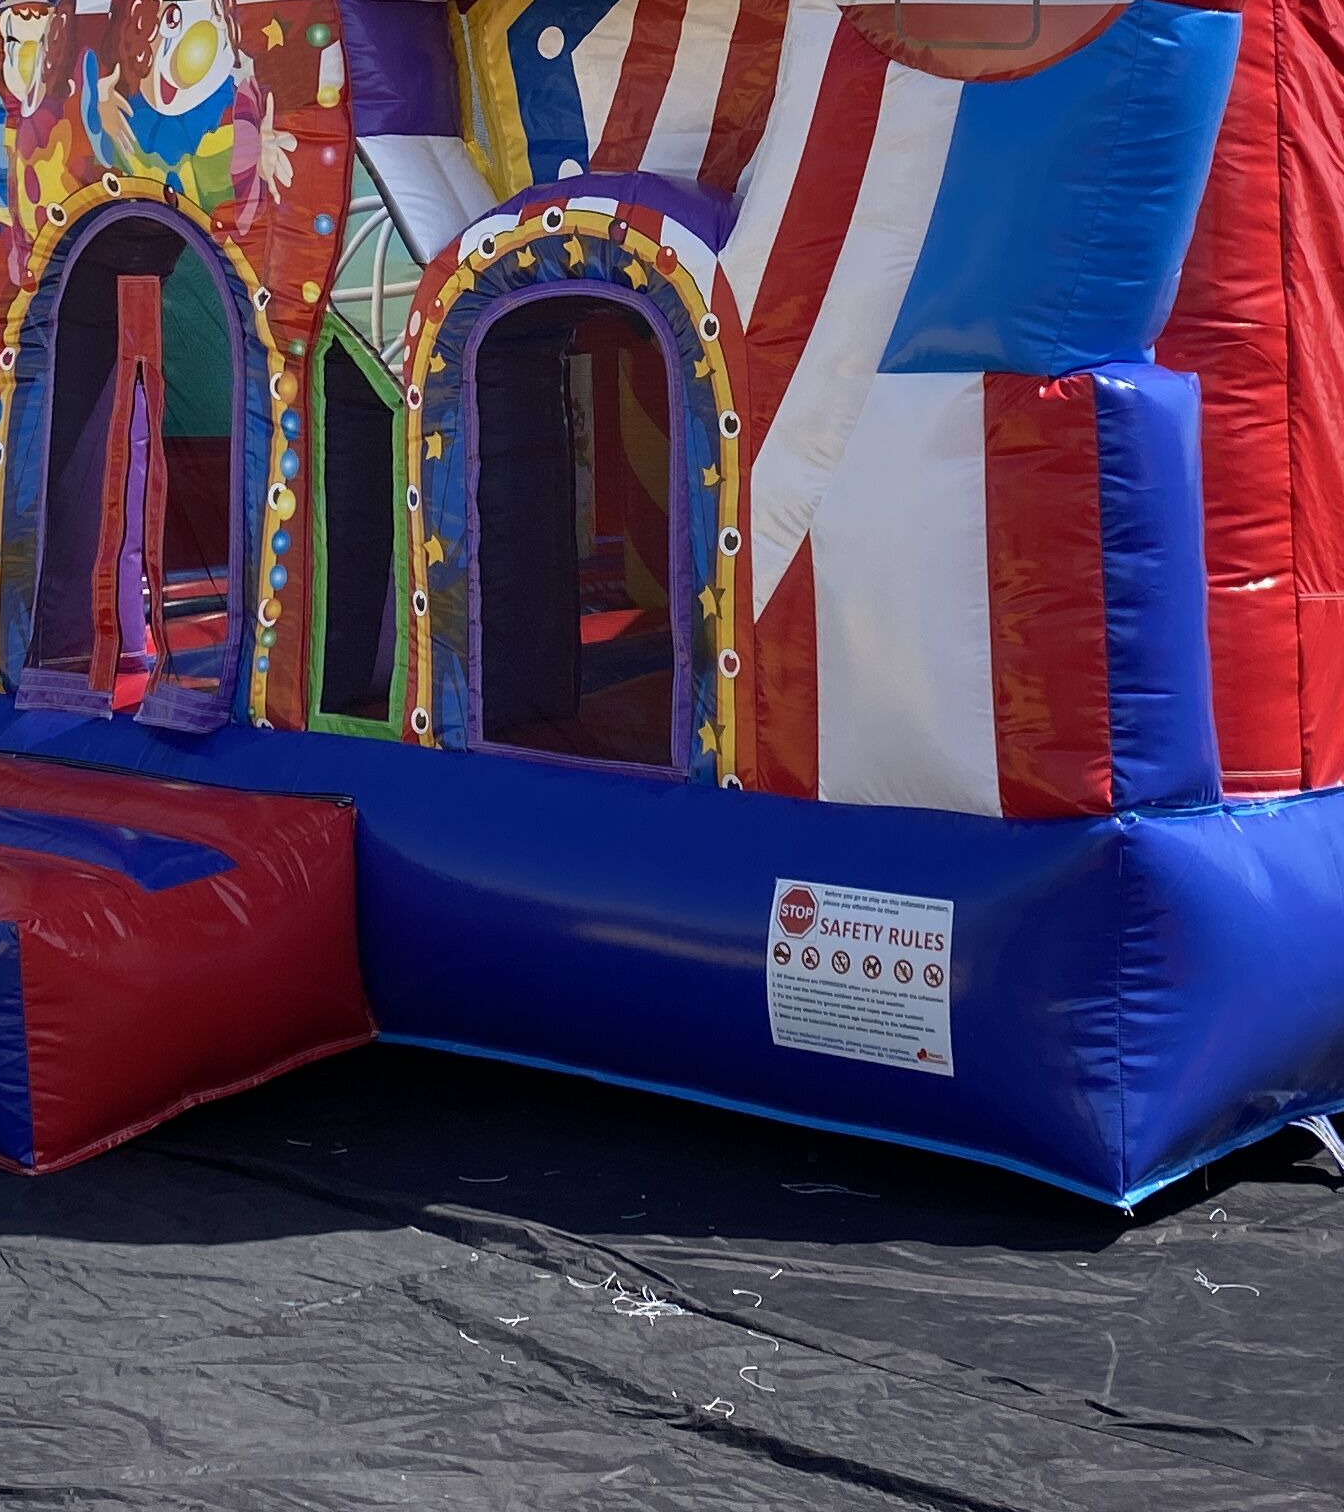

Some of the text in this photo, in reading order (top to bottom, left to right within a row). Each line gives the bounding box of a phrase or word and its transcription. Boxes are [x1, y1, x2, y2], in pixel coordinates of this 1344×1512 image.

[781, 903, 813, 919] STOP
[820, 918, 944, 951] SAFETY RULES
